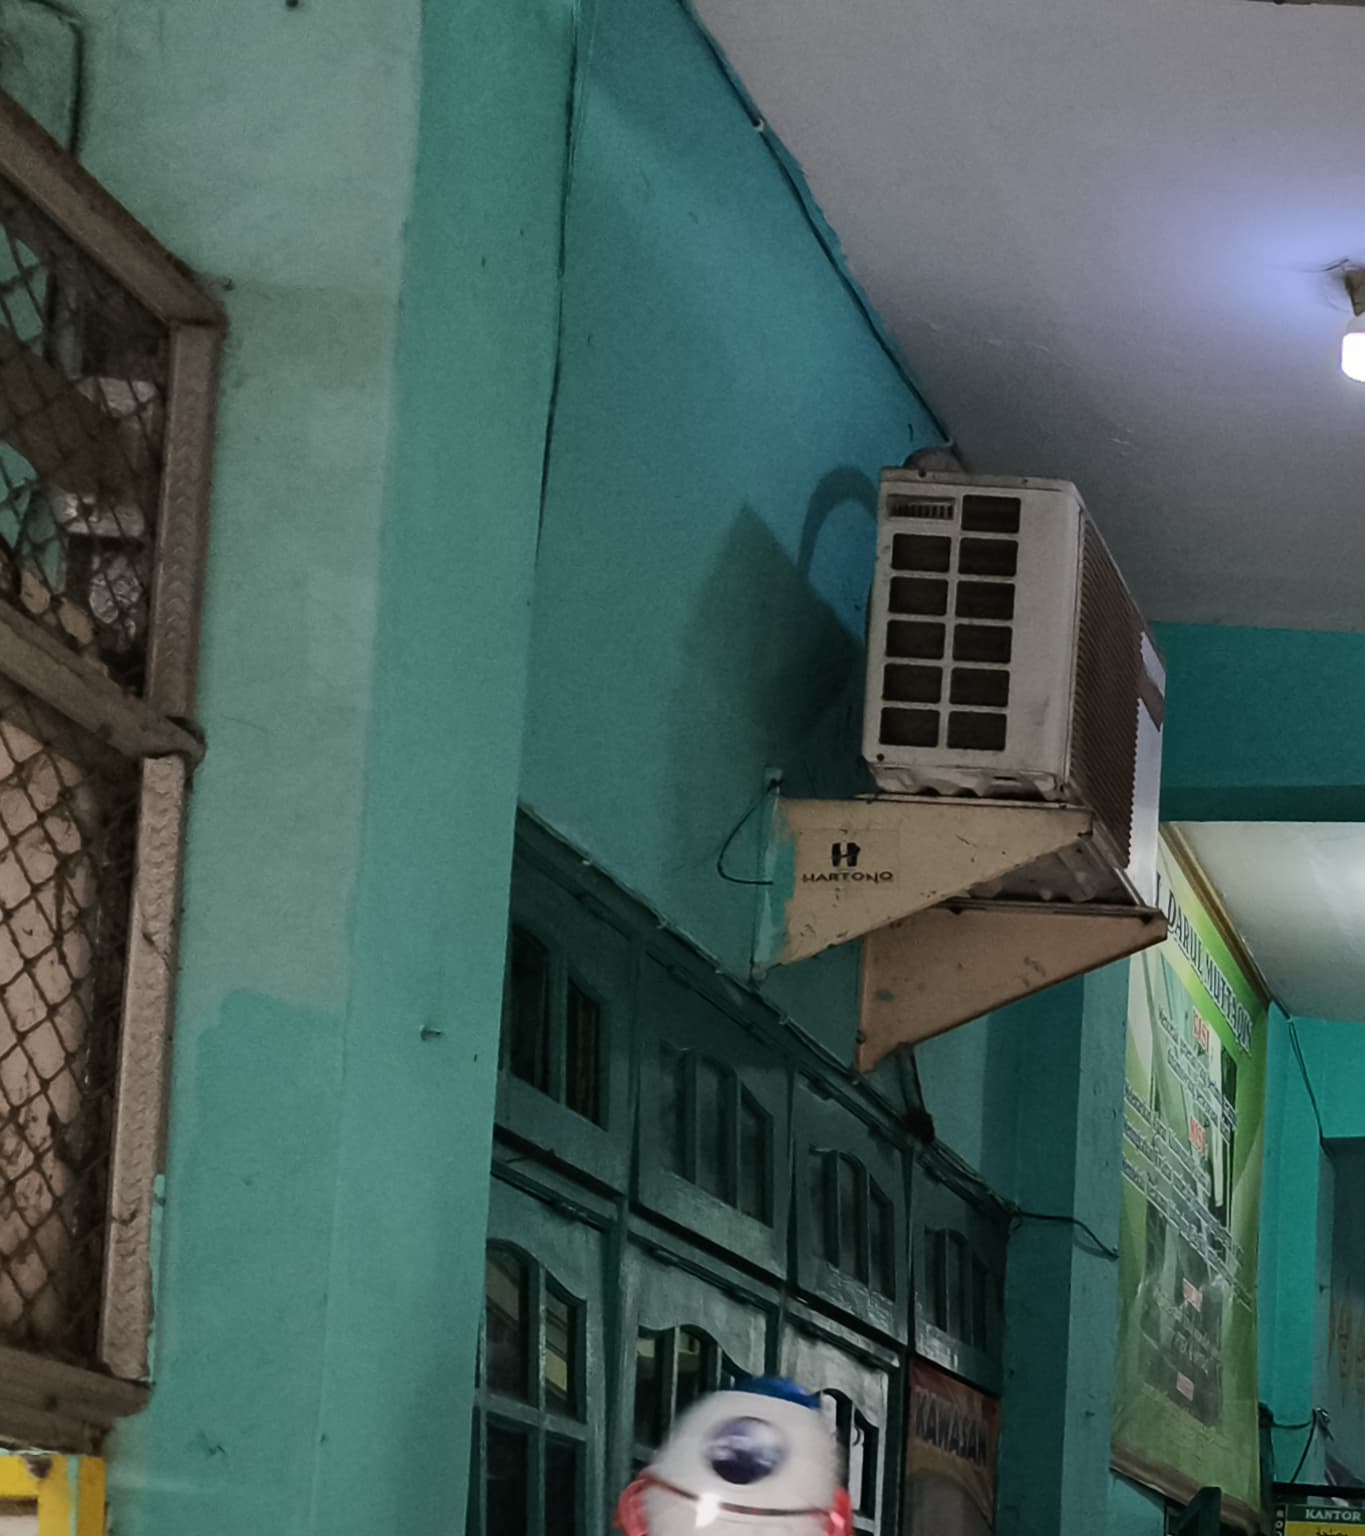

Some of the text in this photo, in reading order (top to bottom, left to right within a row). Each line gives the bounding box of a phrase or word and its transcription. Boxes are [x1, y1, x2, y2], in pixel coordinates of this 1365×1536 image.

[802, 871, 894, 883] HARTONO
[1167, 889, 1204, 977] DARUL
[1205, 953, 1252, 1052] MUTTAQIN
[1305, 1508, 1362, 1521] KANTOR
